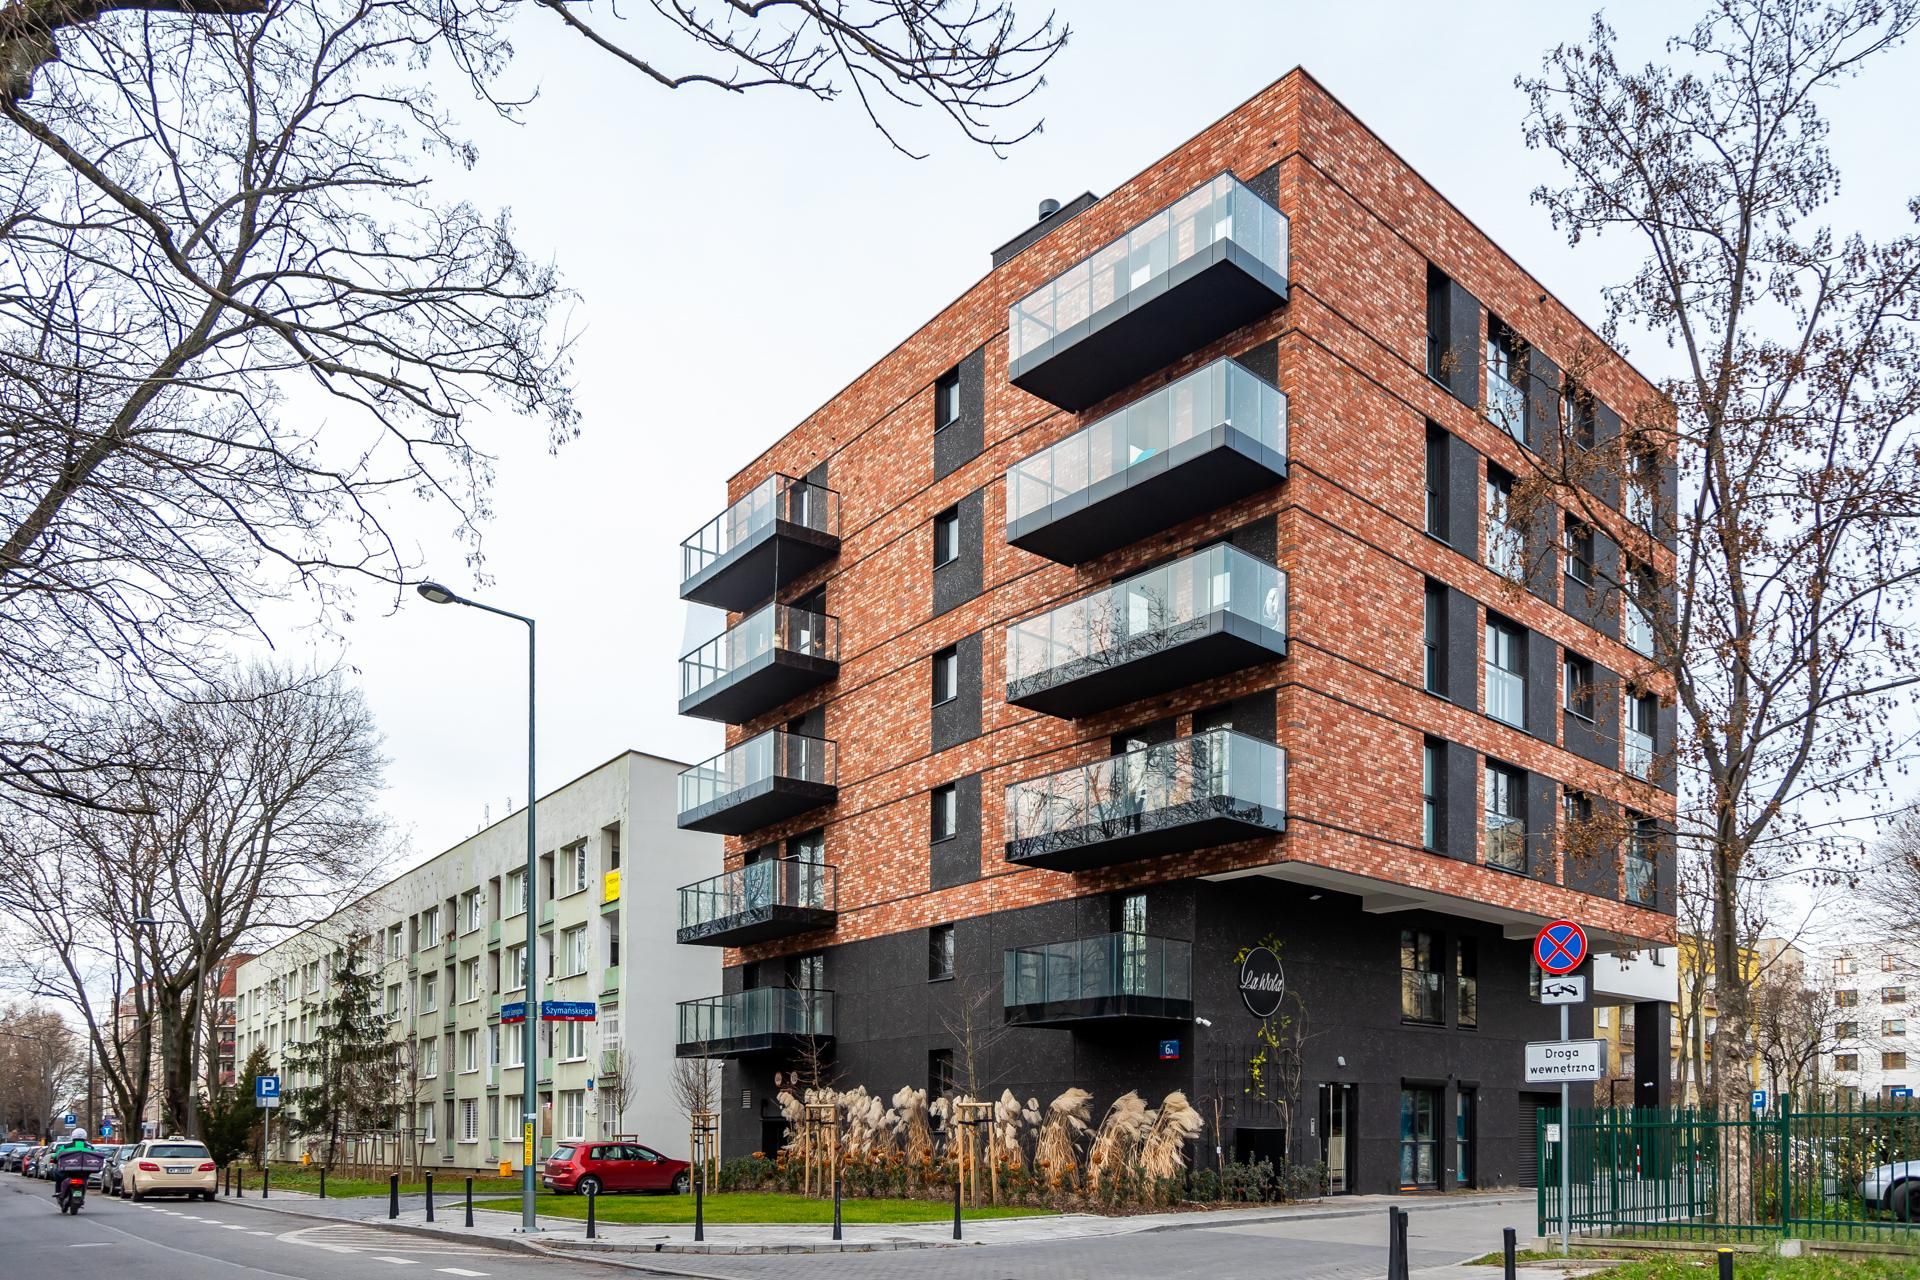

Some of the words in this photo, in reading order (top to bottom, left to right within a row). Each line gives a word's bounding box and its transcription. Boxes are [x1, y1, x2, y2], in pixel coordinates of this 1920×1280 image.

[1240, 970, 1258, 989] La
[545, 1006, 593, 1016] Szymańskiego
[1545, 1048, 1579, 1060] Droga
[1530, 1064, 1595, 1075] wewnętrzna
[262, 1078, 275, 1095] P
[1752, 1092, 1763, 1105] P
